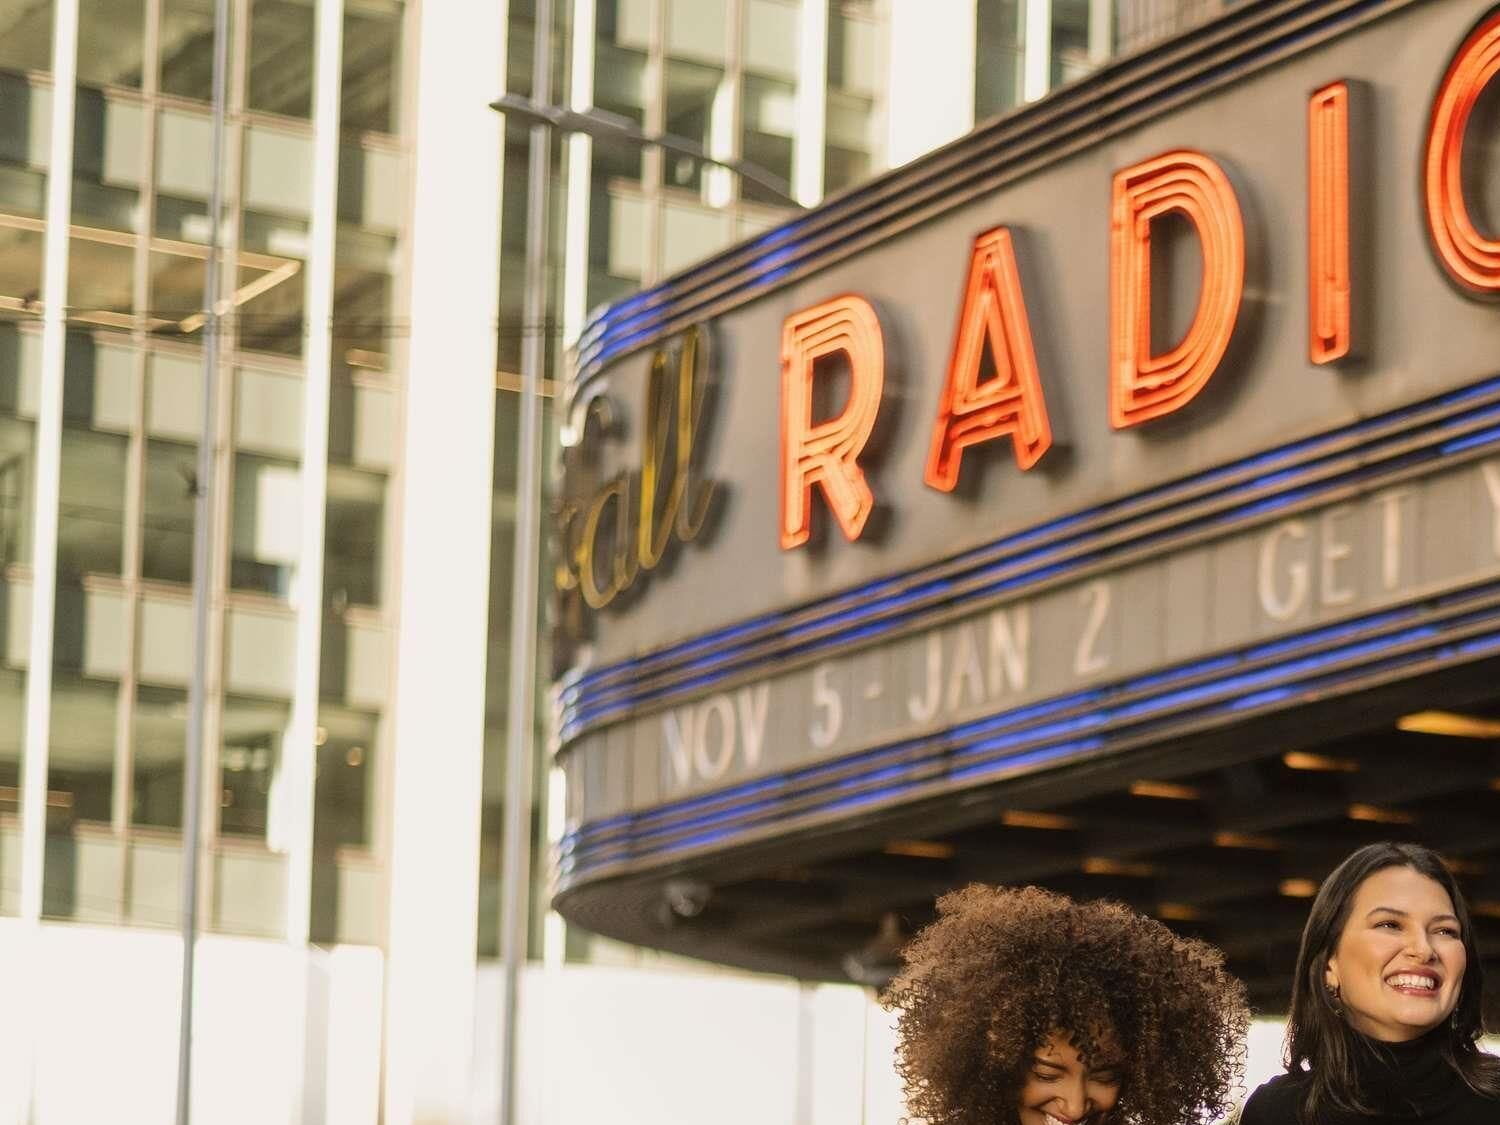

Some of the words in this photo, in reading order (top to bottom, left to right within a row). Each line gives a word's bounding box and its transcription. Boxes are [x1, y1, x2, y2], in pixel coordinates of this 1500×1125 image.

[661, 682, 770, 787] NOV
[810, 663, 843, 748] 5
[908, 604, 1030, 722] JAN
[1073, 581, 1112, 675] 2
[1256, 486, 1410, 622] GET
